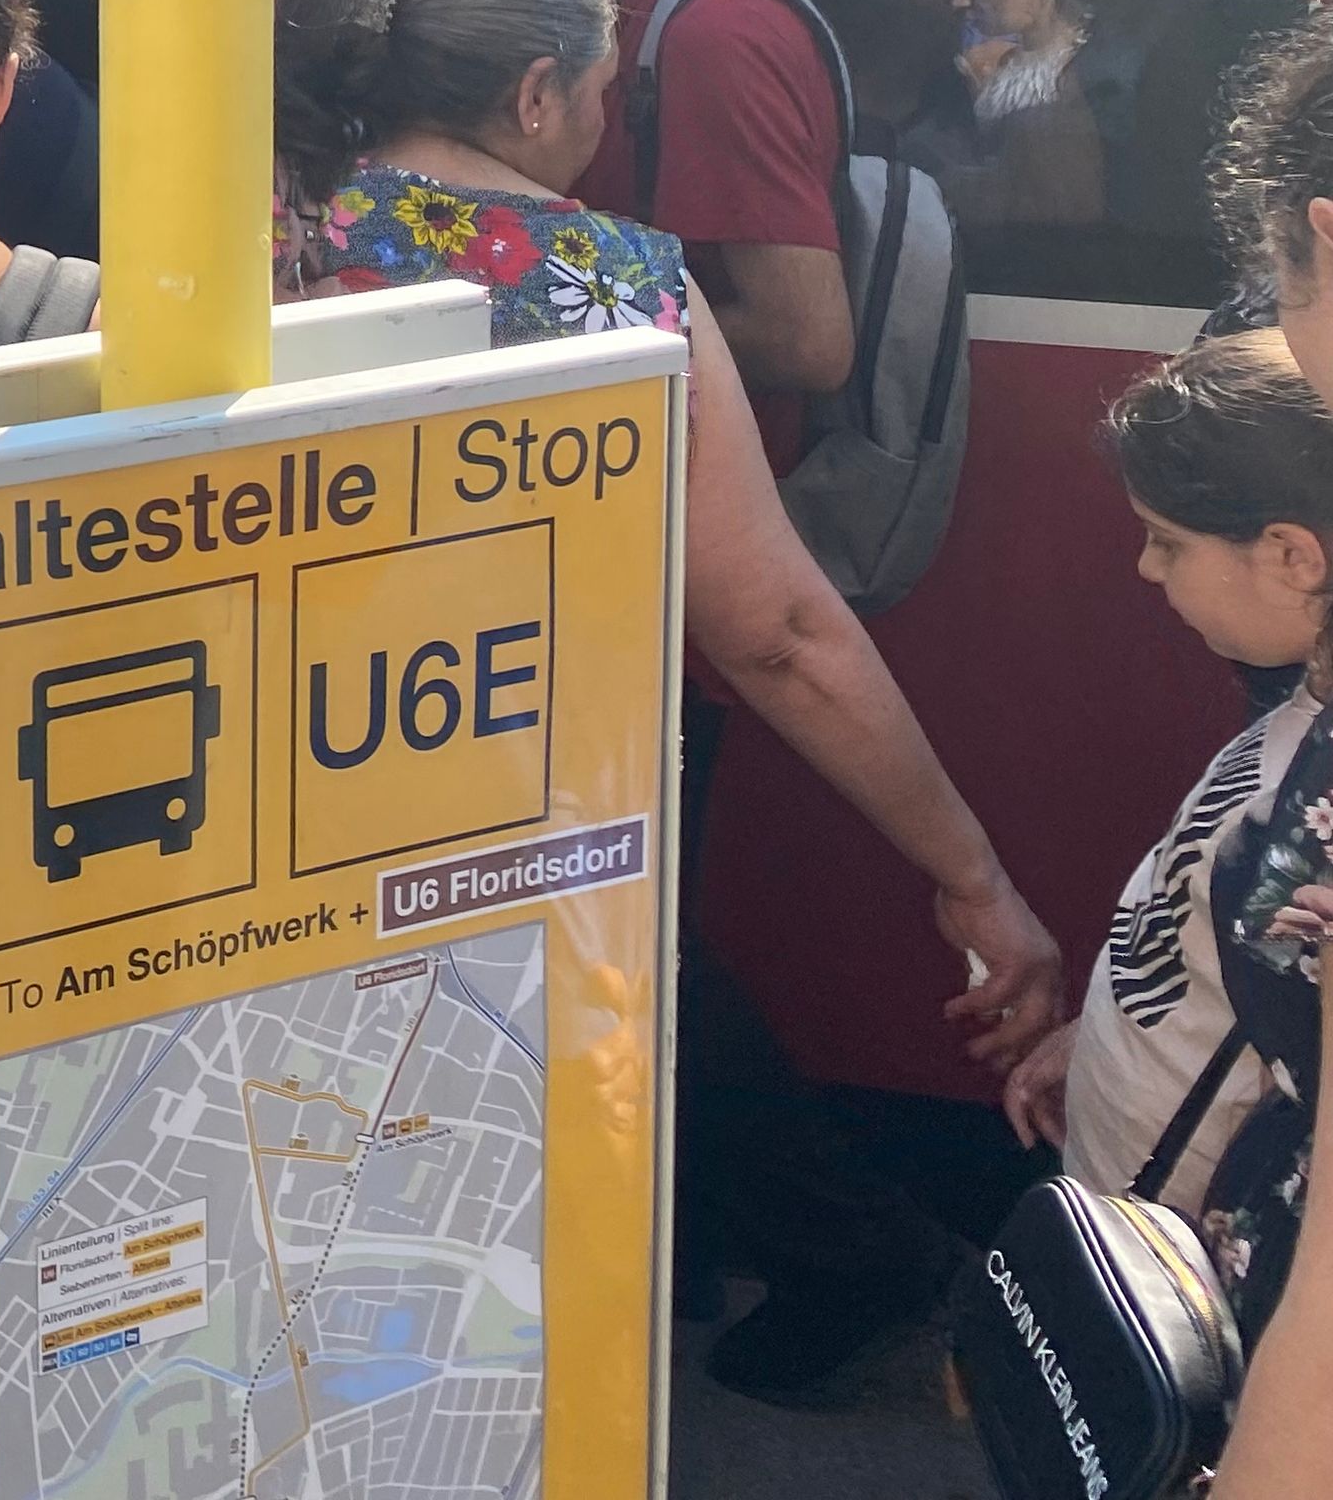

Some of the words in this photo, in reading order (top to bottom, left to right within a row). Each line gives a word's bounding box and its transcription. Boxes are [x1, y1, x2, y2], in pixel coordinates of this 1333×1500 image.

[454, 417, 641, 503] Stop
[309, 620, 542, 770] U6E
[394, 878, 440, 917] U6
[450, 834, 632, 905] Floridsdorf
[55, 964, 115, 1002] Am
[127, 903, 339, 981] Schöpfwerk
[41, 1231, 115, 1261] Linienteilung
[124, 1220, 149, 1238] Split
[152, 1214, 173, 1228] line:
[60, 1251, 113, 1276] Floridsdorf
[41, 1298, 111, 1328] Alternativen
[60, 1271, 122, 1296] Siebenhirten
[988, 1250, 1041, 1348] CALVIN
[1035, 1338, 1078, 1422] KLEIN
